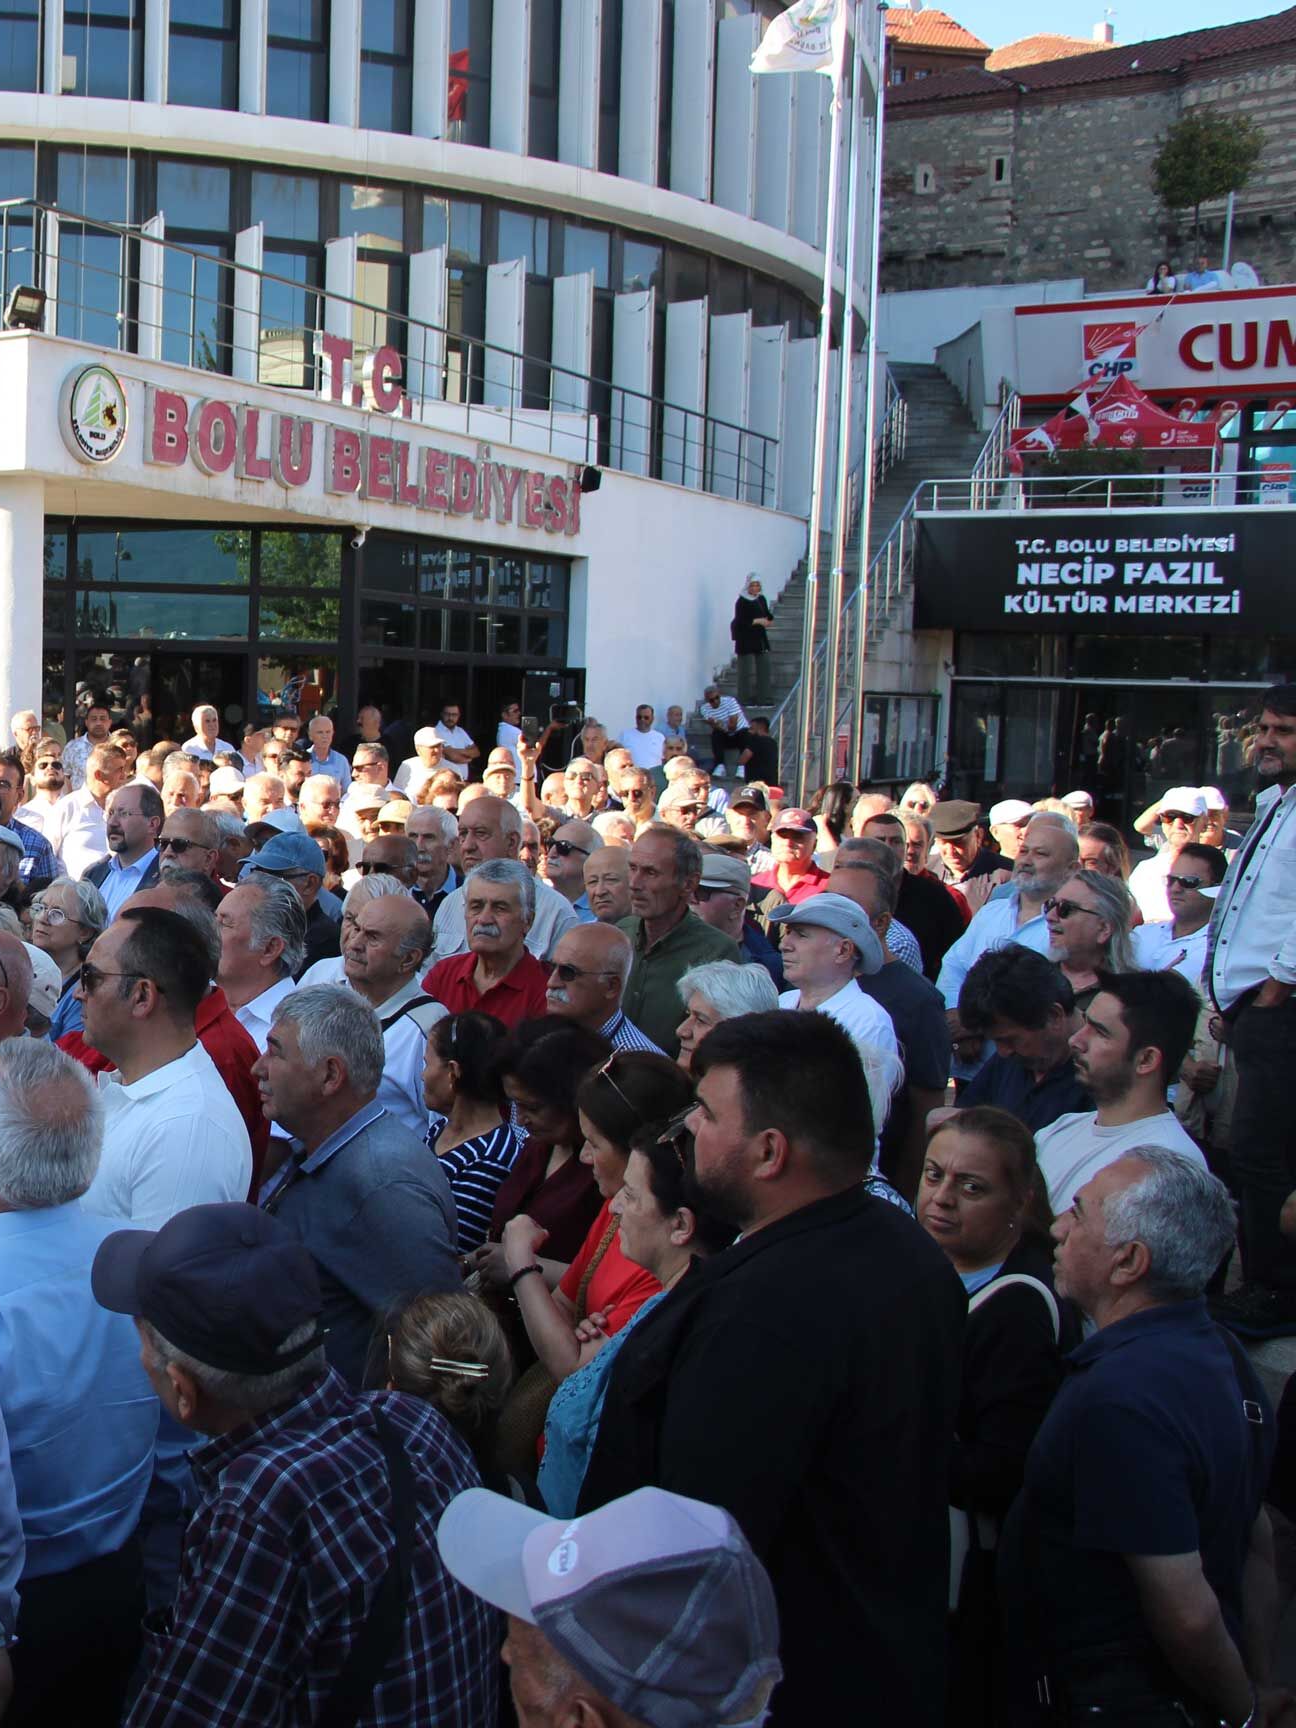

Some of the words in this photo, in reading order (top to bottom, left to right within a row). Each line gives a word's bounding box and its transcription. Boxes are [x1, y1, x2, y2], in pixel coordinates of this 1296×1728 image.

[1179, 320, 1296, 371] CUM
[317, 331, 412, 420] T.C.
[1088, 361, 1132, 378] CHP
[146, 385, 313, 489] BOLU
[1016, 539, 1051, 553] T.C.
[1055, 539, 1110, 553] BOLU
[1115, 533, 1236, 553] BELEDİYESİ
[1016, 556, 1115, 584] NECİP
[1123, 562, 1224, 584] FAZIL
[1004, 590, 1108, 614] KÜLTÜR
[1114, 590, 1240, 614] MERKEZİ
